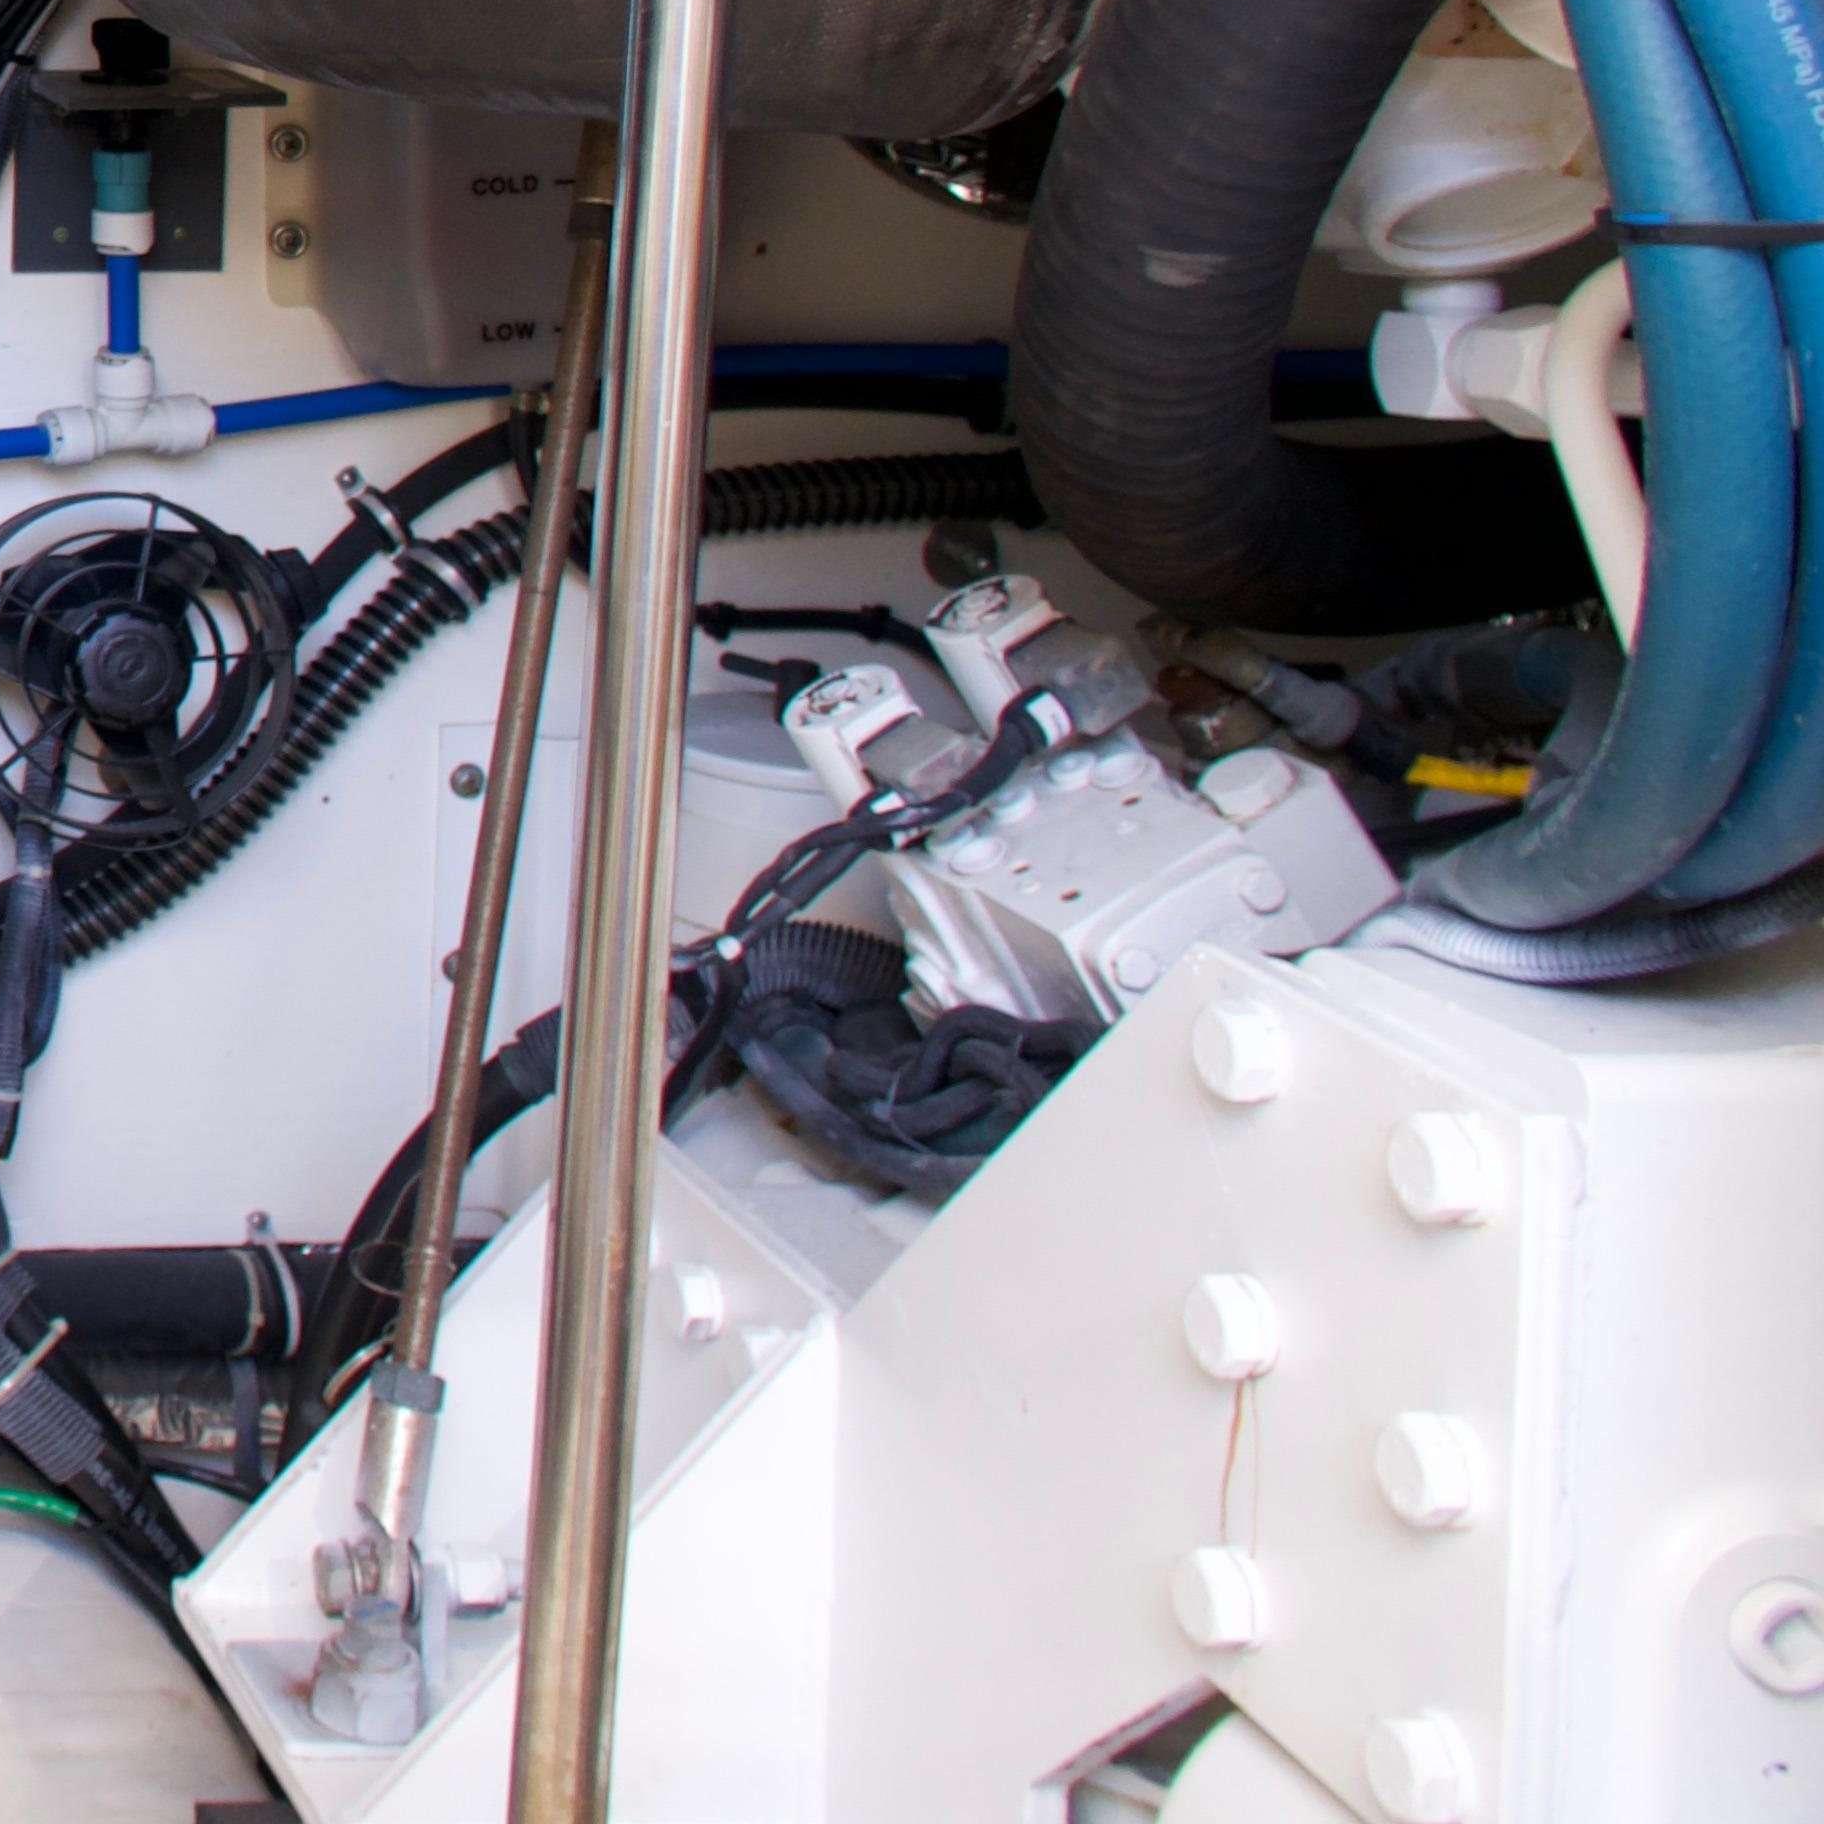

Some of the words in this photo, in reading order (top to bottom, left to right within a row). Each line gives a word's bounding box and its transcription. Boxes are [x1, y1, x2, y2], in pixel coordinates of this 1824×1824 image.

[1780, 25, 1822, 87] MPa)
[471, 174, 540, 197] COLD
[480, 321, 537, 344] LOW
